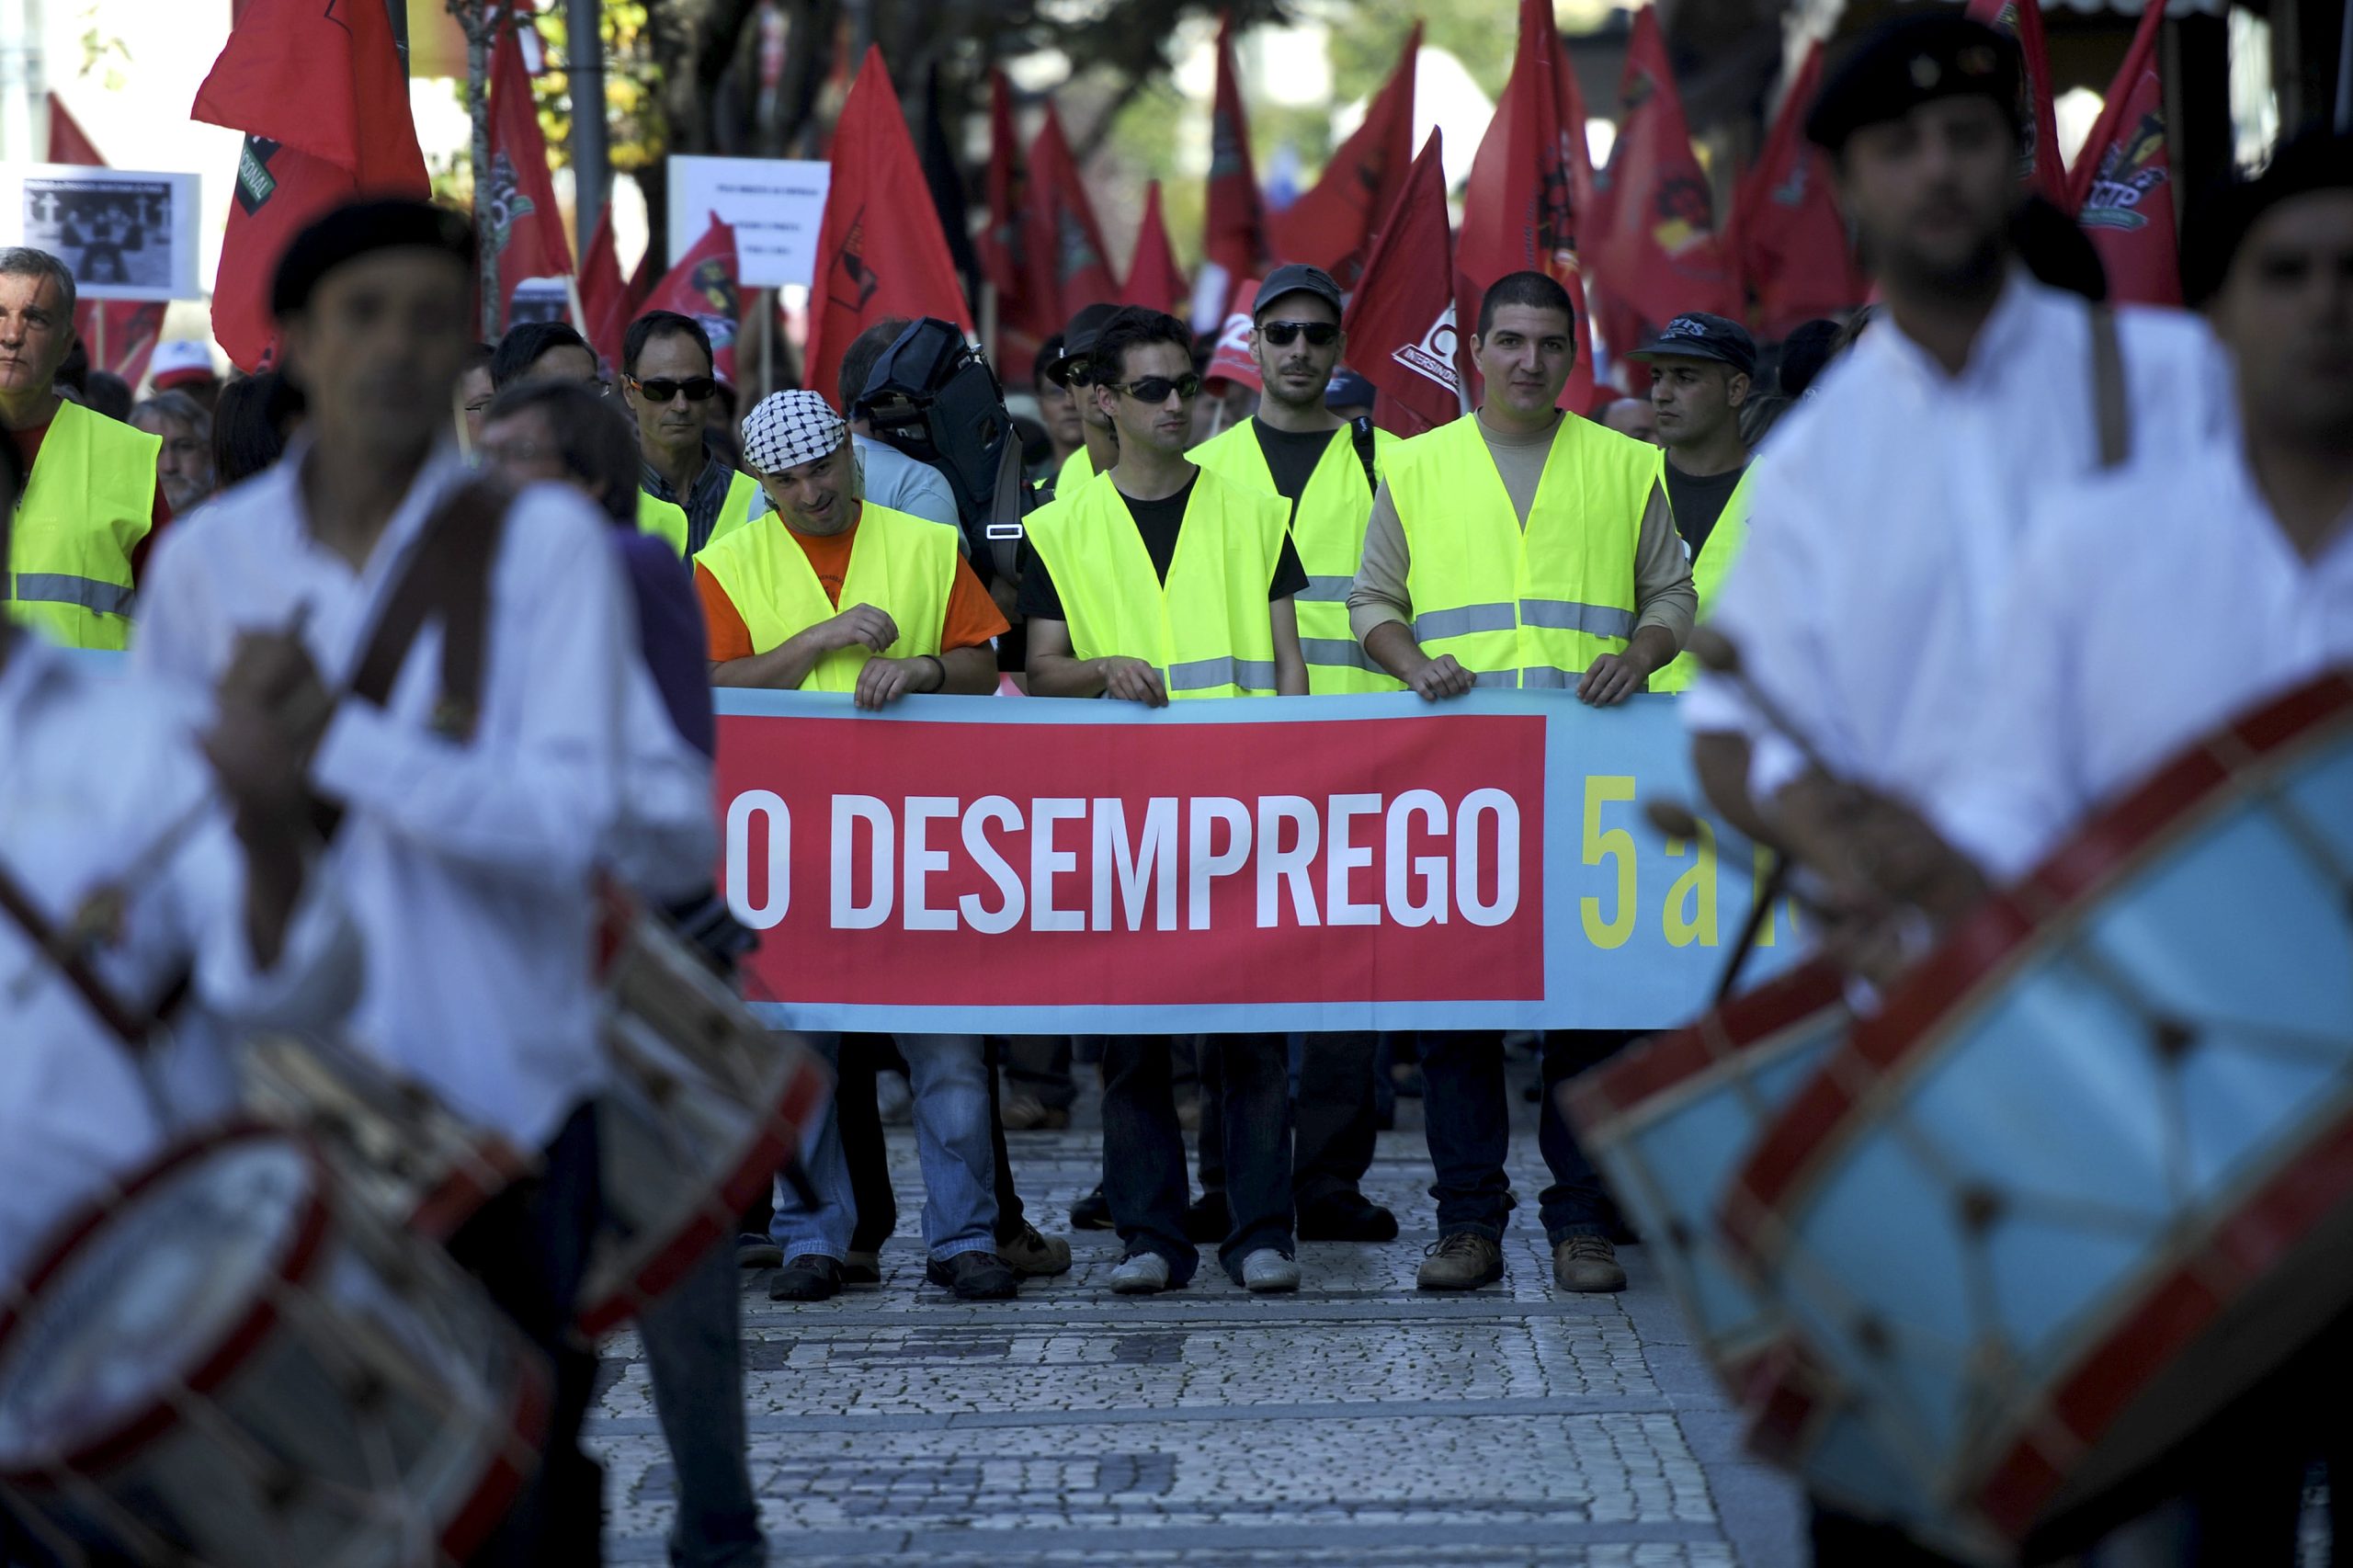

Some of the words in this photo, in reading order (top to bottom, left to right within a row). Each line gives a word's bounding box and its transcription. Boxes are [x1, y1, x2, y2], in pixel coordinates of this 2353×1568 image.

[240, 148, 268, 199] CIONAL
[726, 790, 791, 930] O
[830, 789, 1520, 935] DESEMPREGO
[1580, 776, 1636, 949] 5
[1663, 818, 1718, 948] a
